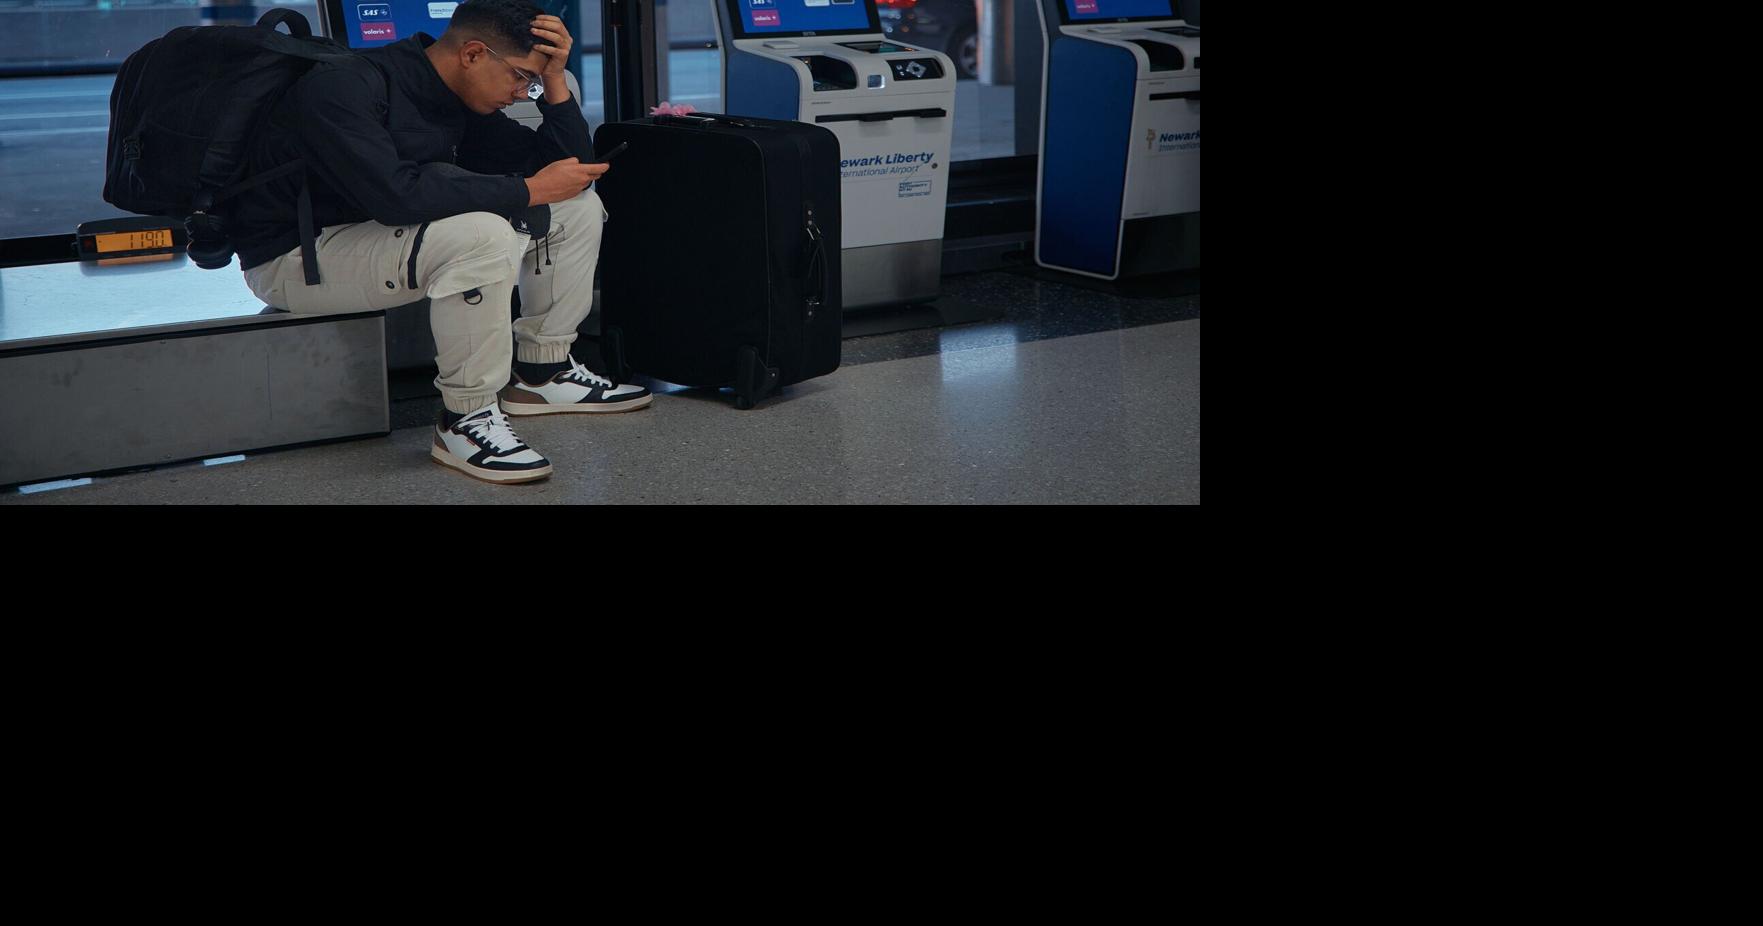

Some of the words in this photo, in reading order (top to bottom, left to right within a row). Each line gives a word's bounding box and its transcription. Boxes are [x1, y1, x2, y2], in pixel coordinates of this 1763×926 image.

[840, 155, 884, 168] ewark
[885, 151, 934, 164] Liberty
[890, 165, 920, 176] Airport
